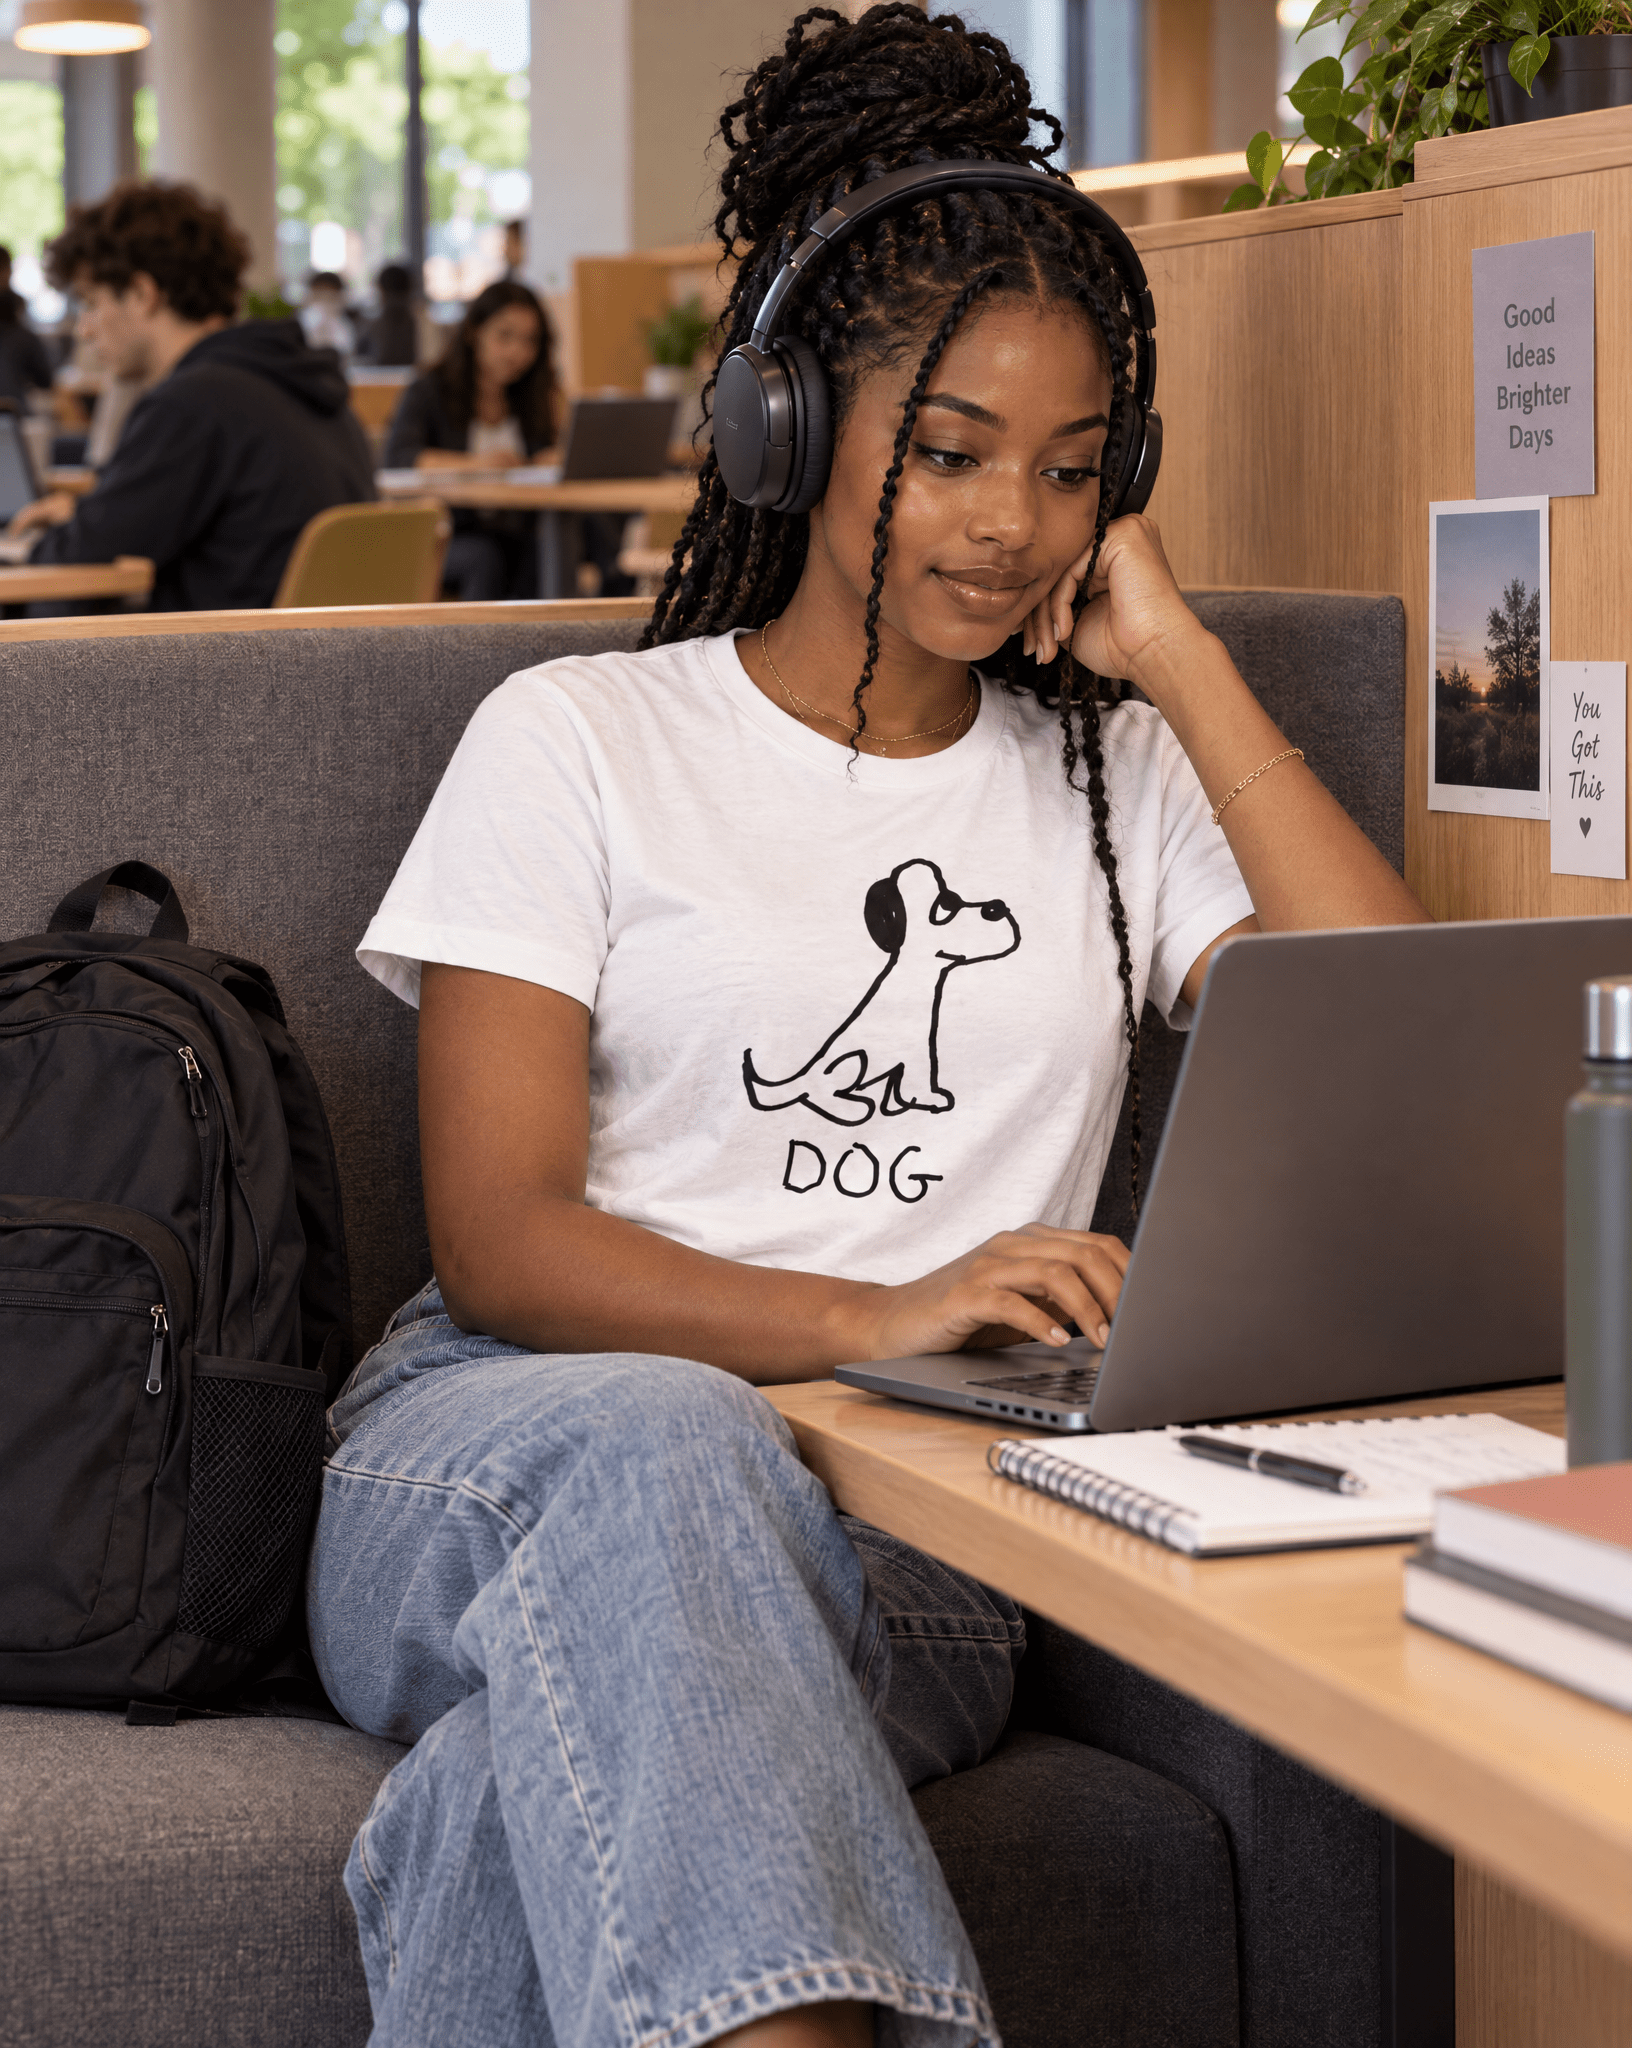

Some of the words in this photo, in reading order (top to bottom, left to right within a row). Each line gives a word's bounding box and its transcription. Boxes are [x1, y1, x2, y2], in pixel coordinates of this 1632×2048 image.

[1503, 296, 1555, 328] Good
[1506, 342, 1555, 369] Ideas
[1497, 381, 1571, 415] Brighter
[1509, 425, 1554, 454] Days
[1573, 691, 1602, 722] You
[1571, 730, 1601, 764] Got
[1568, 770, 1605, 801] This
[782, 1139, 943, 1203] DOG
